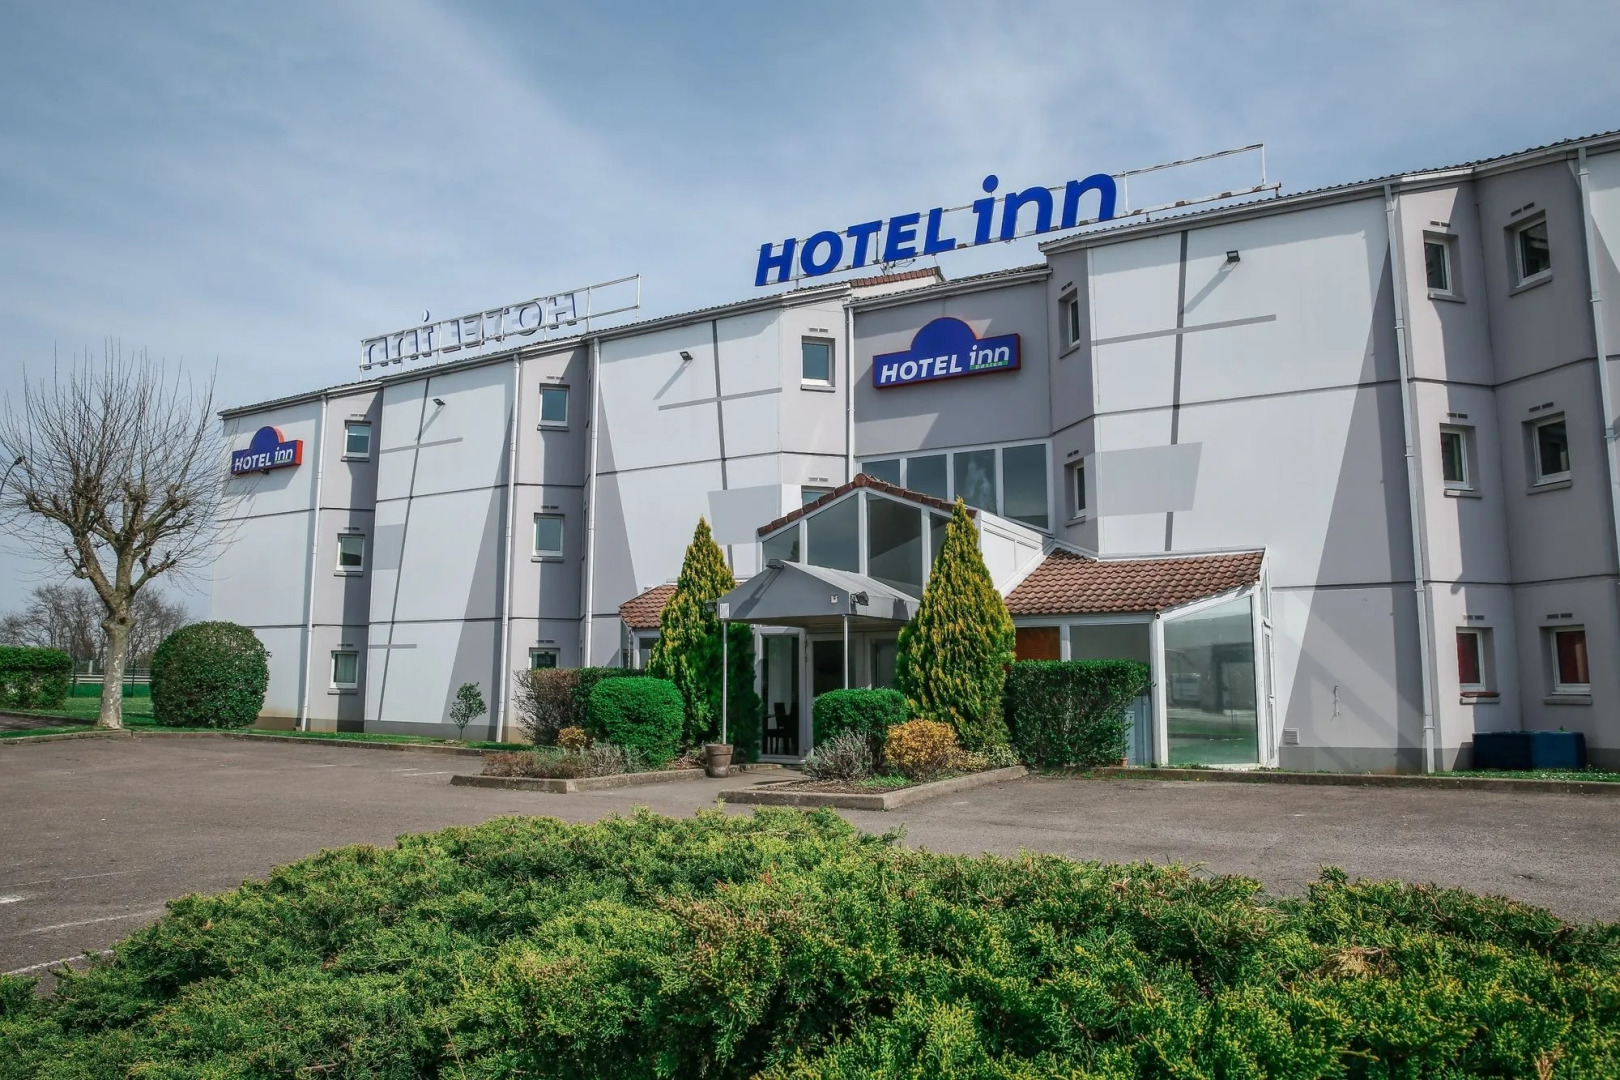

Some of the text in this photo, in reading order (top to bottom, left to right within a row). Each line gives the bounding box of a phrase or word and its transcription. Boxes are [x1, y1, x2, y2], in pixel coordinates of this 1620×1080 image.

[755, 173, 1117, 287] HOTEL inn
[880, 344, 1010, 383] HOTEL inn
[234, 452, 272, 471] HOTEL
[274, 446, 293, 461] inn
